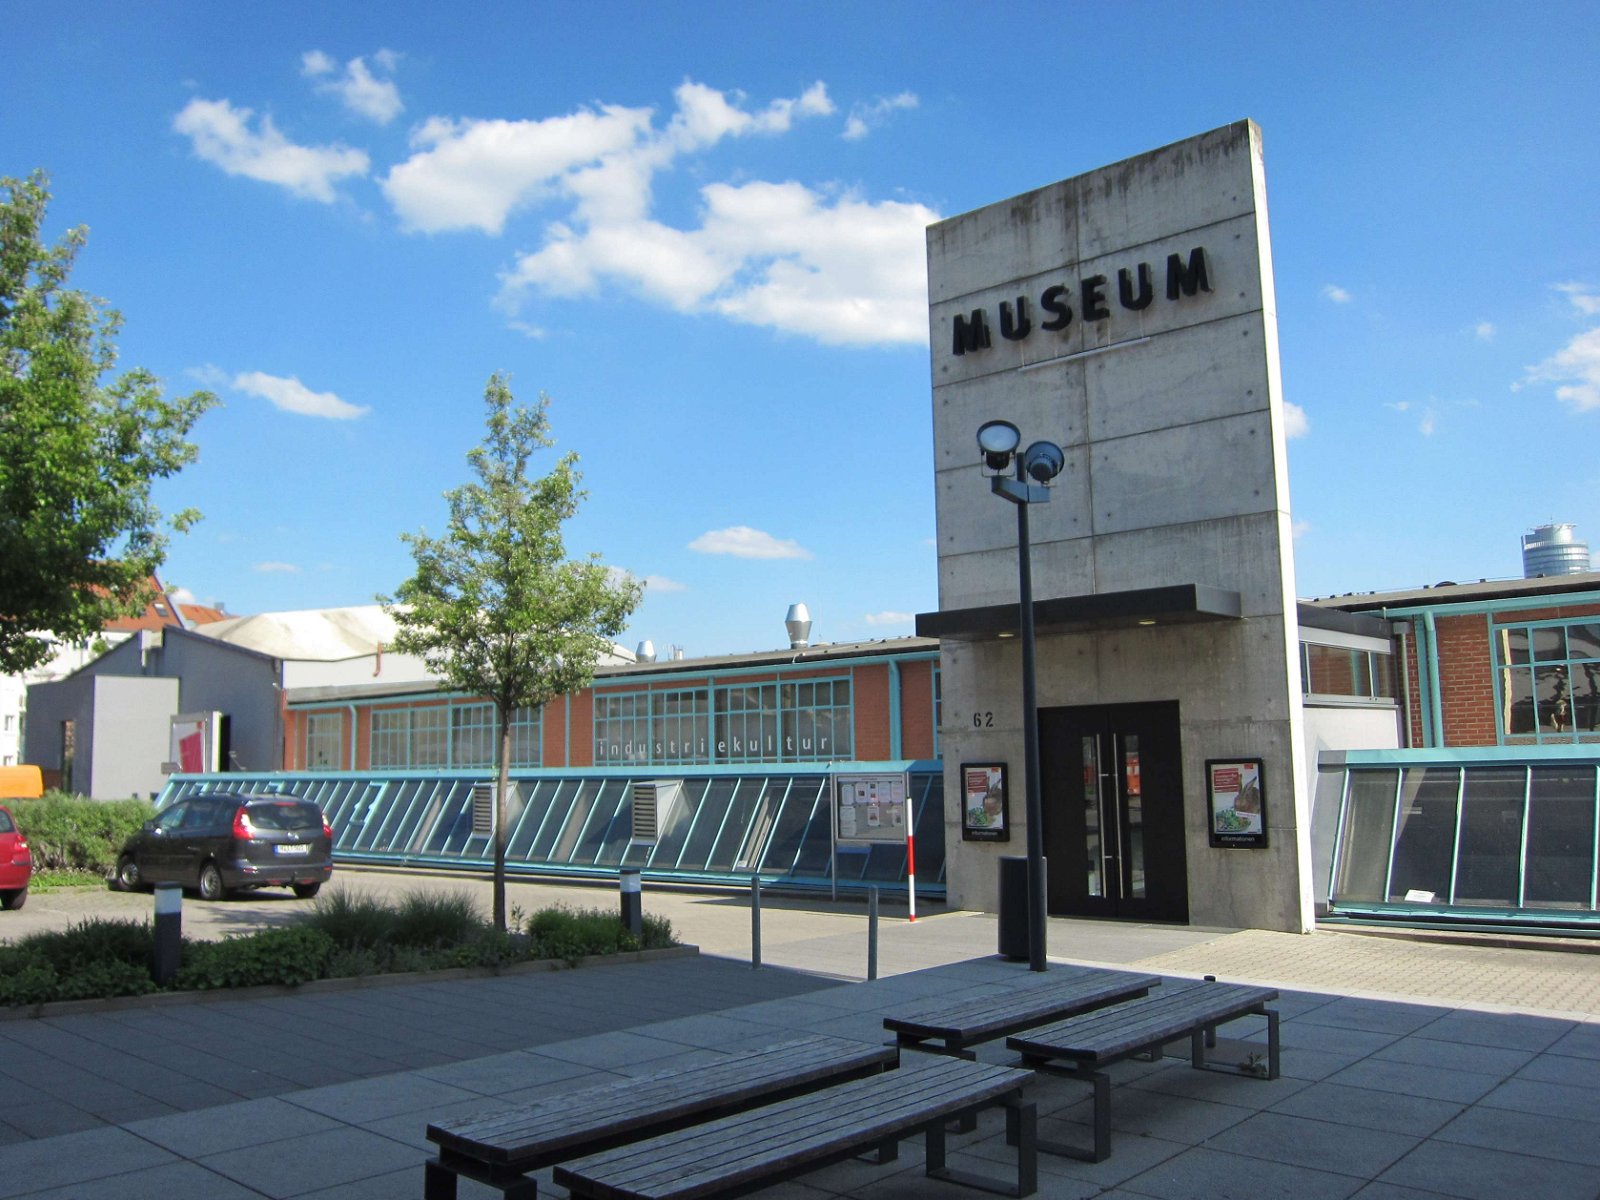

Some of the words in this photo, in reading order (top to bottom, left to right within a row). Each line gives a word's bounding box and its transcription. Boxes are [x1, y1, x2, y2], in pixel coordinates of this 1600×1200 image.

[952, 246, 1214, 356] MUSEUM
[973, 712, 994, 728] 62
[599, 735, 827, 756] industriekultur
